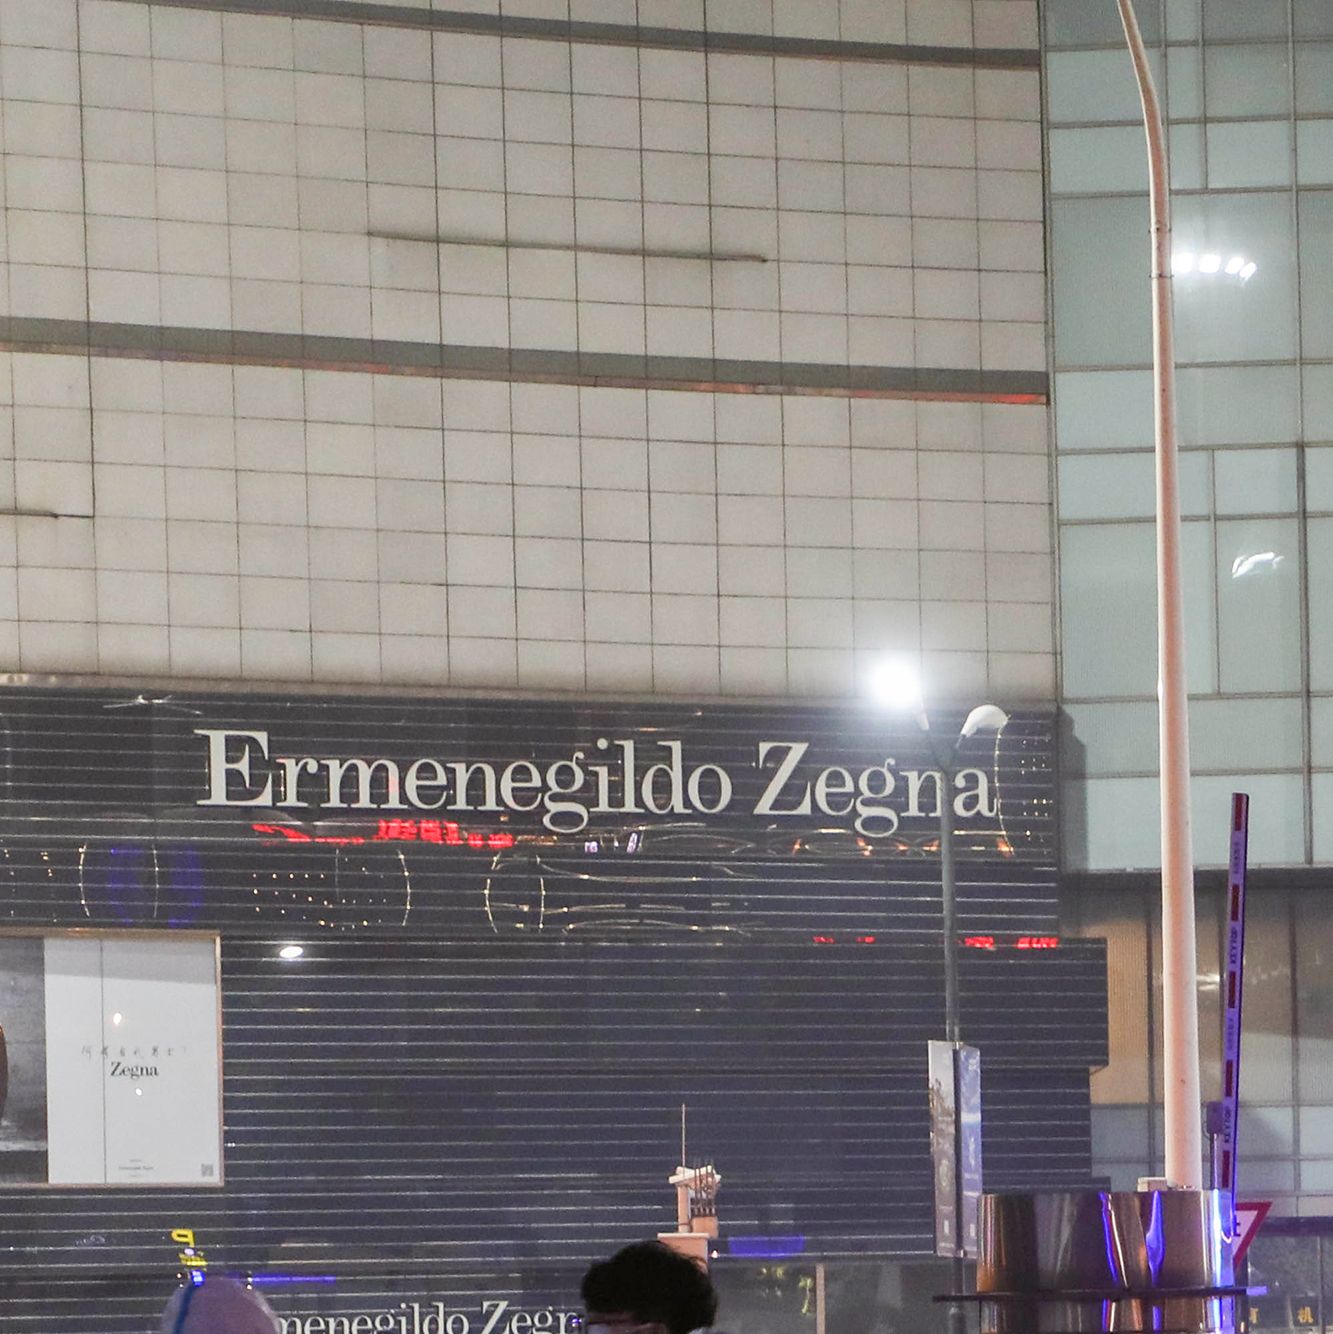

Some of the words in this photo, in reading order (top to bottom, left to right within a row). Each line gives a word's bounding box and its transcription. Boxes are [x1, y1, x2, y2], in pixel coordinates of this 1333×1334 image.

[193, 729, 732, 833] Ermenegildo
[752, 742, 998, 838] Zegna
[111, 1061, 159, 1080] Zegna
